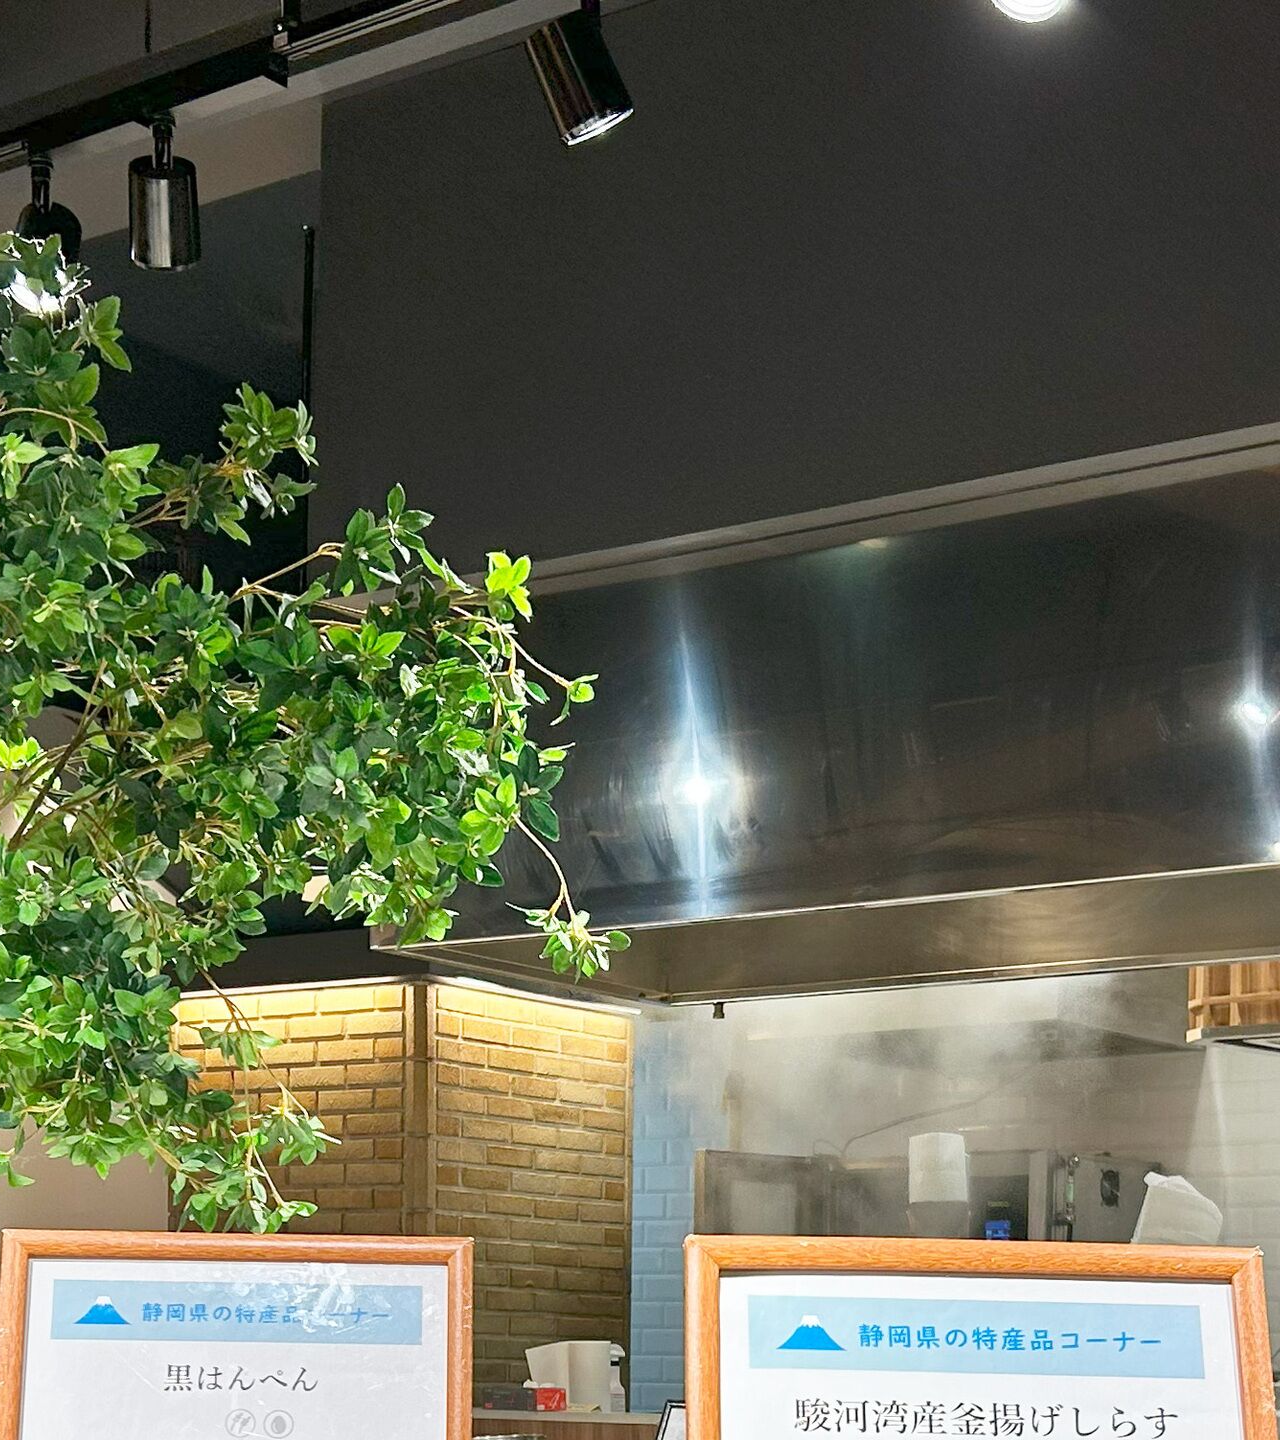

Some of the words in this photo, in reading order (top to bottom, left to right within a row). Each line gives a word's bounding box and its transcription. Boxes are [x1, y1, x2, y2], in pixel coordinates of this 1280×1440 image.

[142, 1302, 390, 1325] 静岡県の特産品ーナー
[857, 1322, 1162, 1352] 静岡県の特産品コーナー
[163, 1363, 318, 1392] 黒はんぺん
[794, 1397, 1179, 1440] 駿河湾産釜揚げしらす
